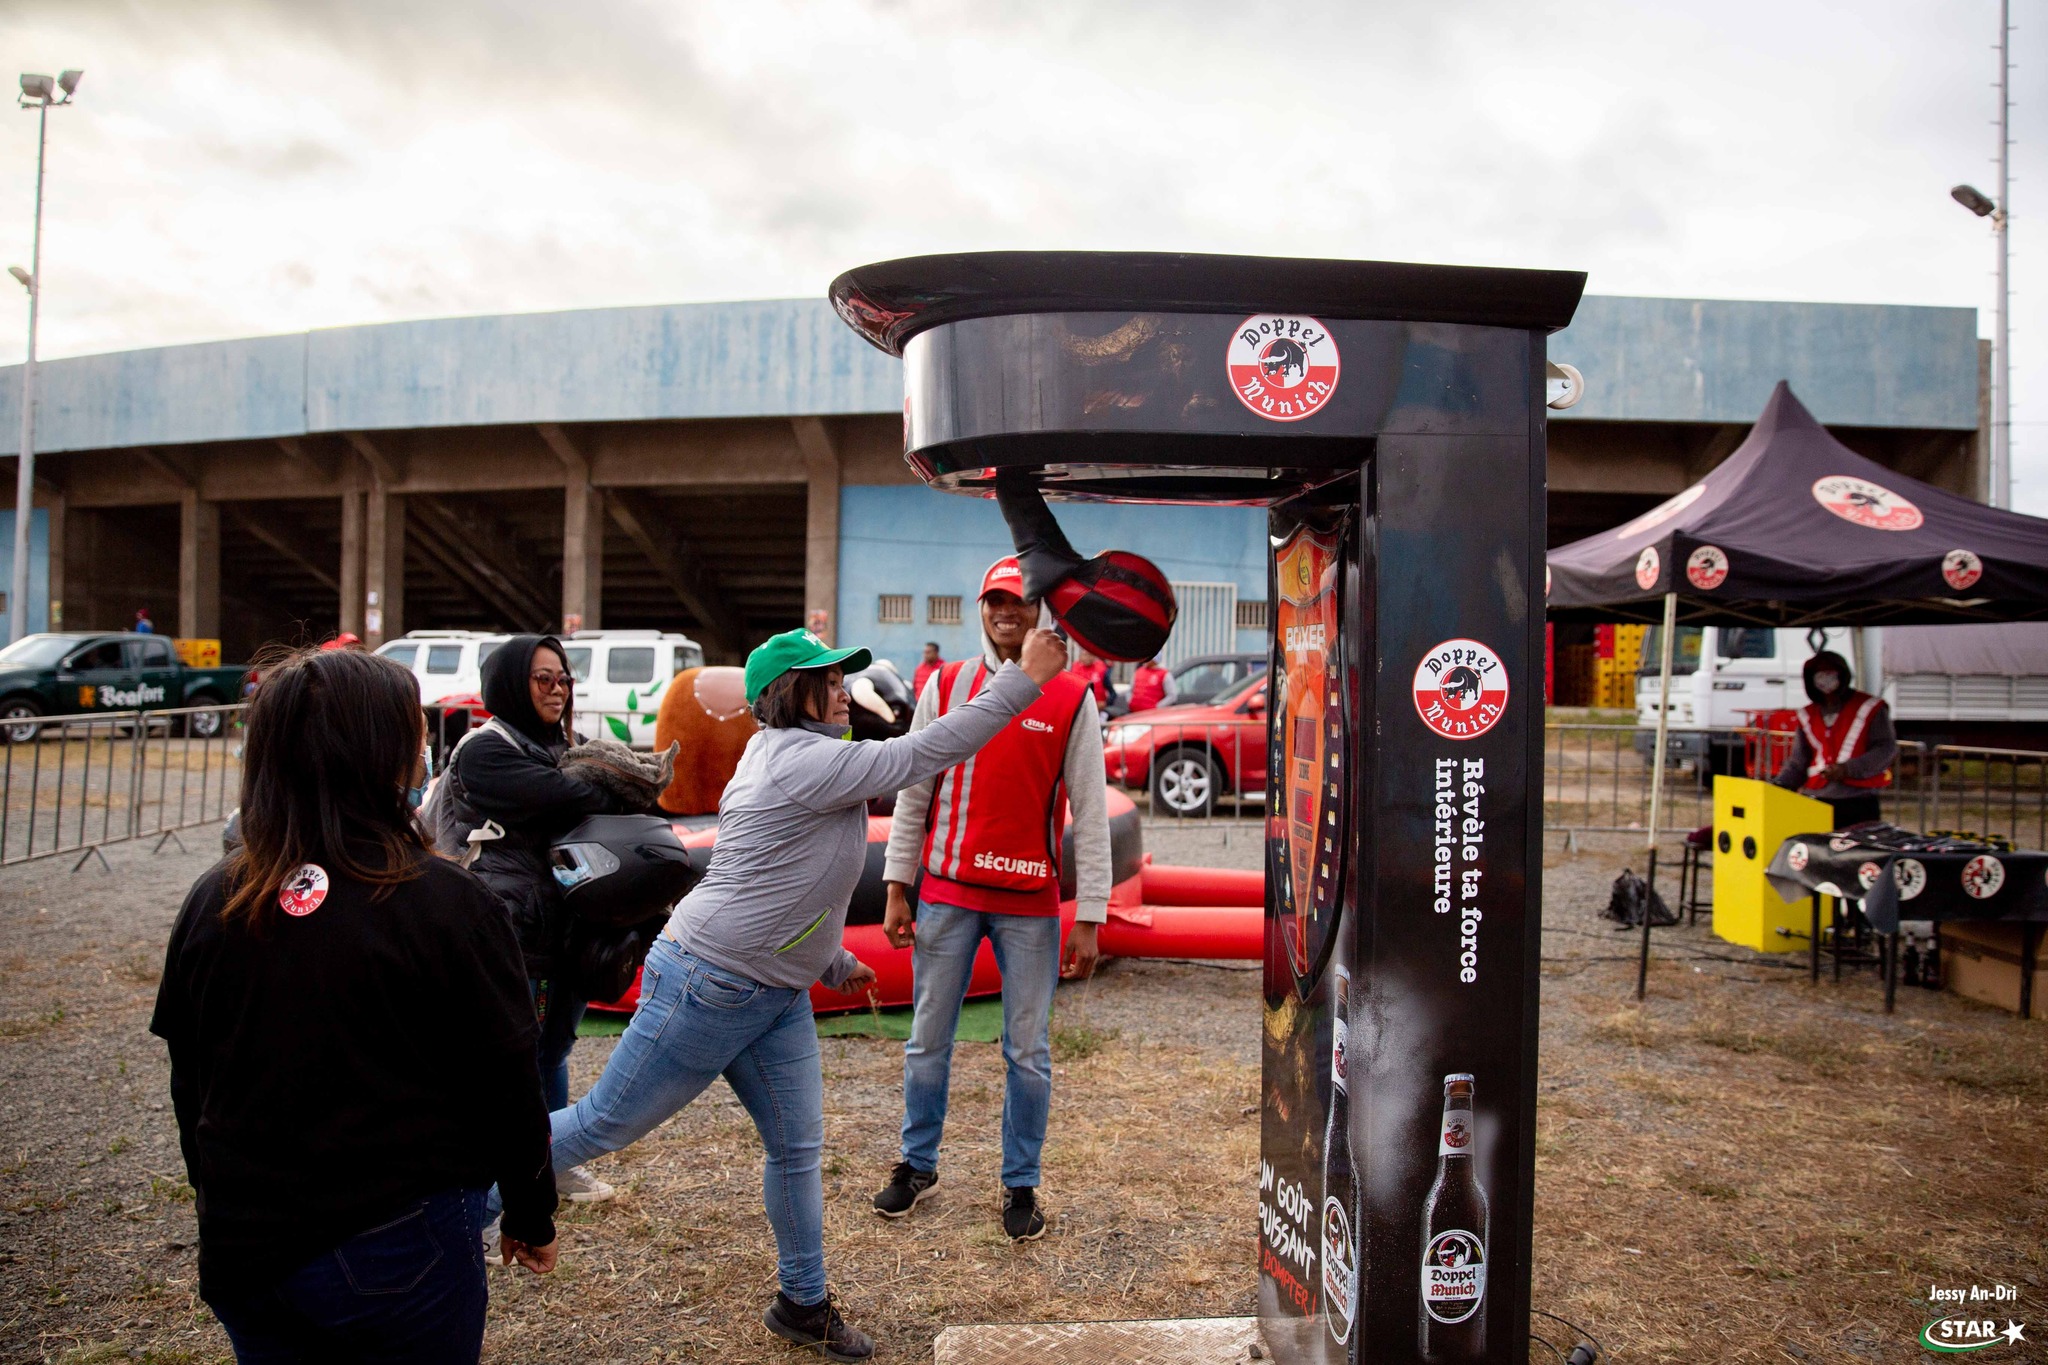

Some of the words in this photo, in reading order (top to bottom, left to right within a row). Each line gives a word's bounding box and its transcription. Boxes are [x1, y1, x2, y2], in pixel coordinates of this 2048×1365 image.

[1240, 318, 1325, 350] Doppel
[1240, 376, 1330, 414] Munich
[996, 567, 1019, 575] STAR
[1286, 623, 1326, 652] BOXER
[1424, 648, 1497, 677] Doppel
[1027, 718, 1046, 729] STAR
[1423, 700, 1500, 734] Munich
[1462, 757, 1485, 862] Révèle
[1434, 758, 1458, 914] intérieure
[973, 851, 1047, 878] SÉCURITÉ
[1461, 868, 1483, 901] ta
[284, 896, 321, 913] Munich
[1460, 906, 1483, 983] force
[1260, 1157, 1275, 1192] UN
[1277, 1177, 1314, 1233] GOÛT
[1259, 1201, 1317, 1280] PUISSANT
[1431, 1267, 1476, 1283] Doppel
[1431, 1282, 1476, 1297] Munich
